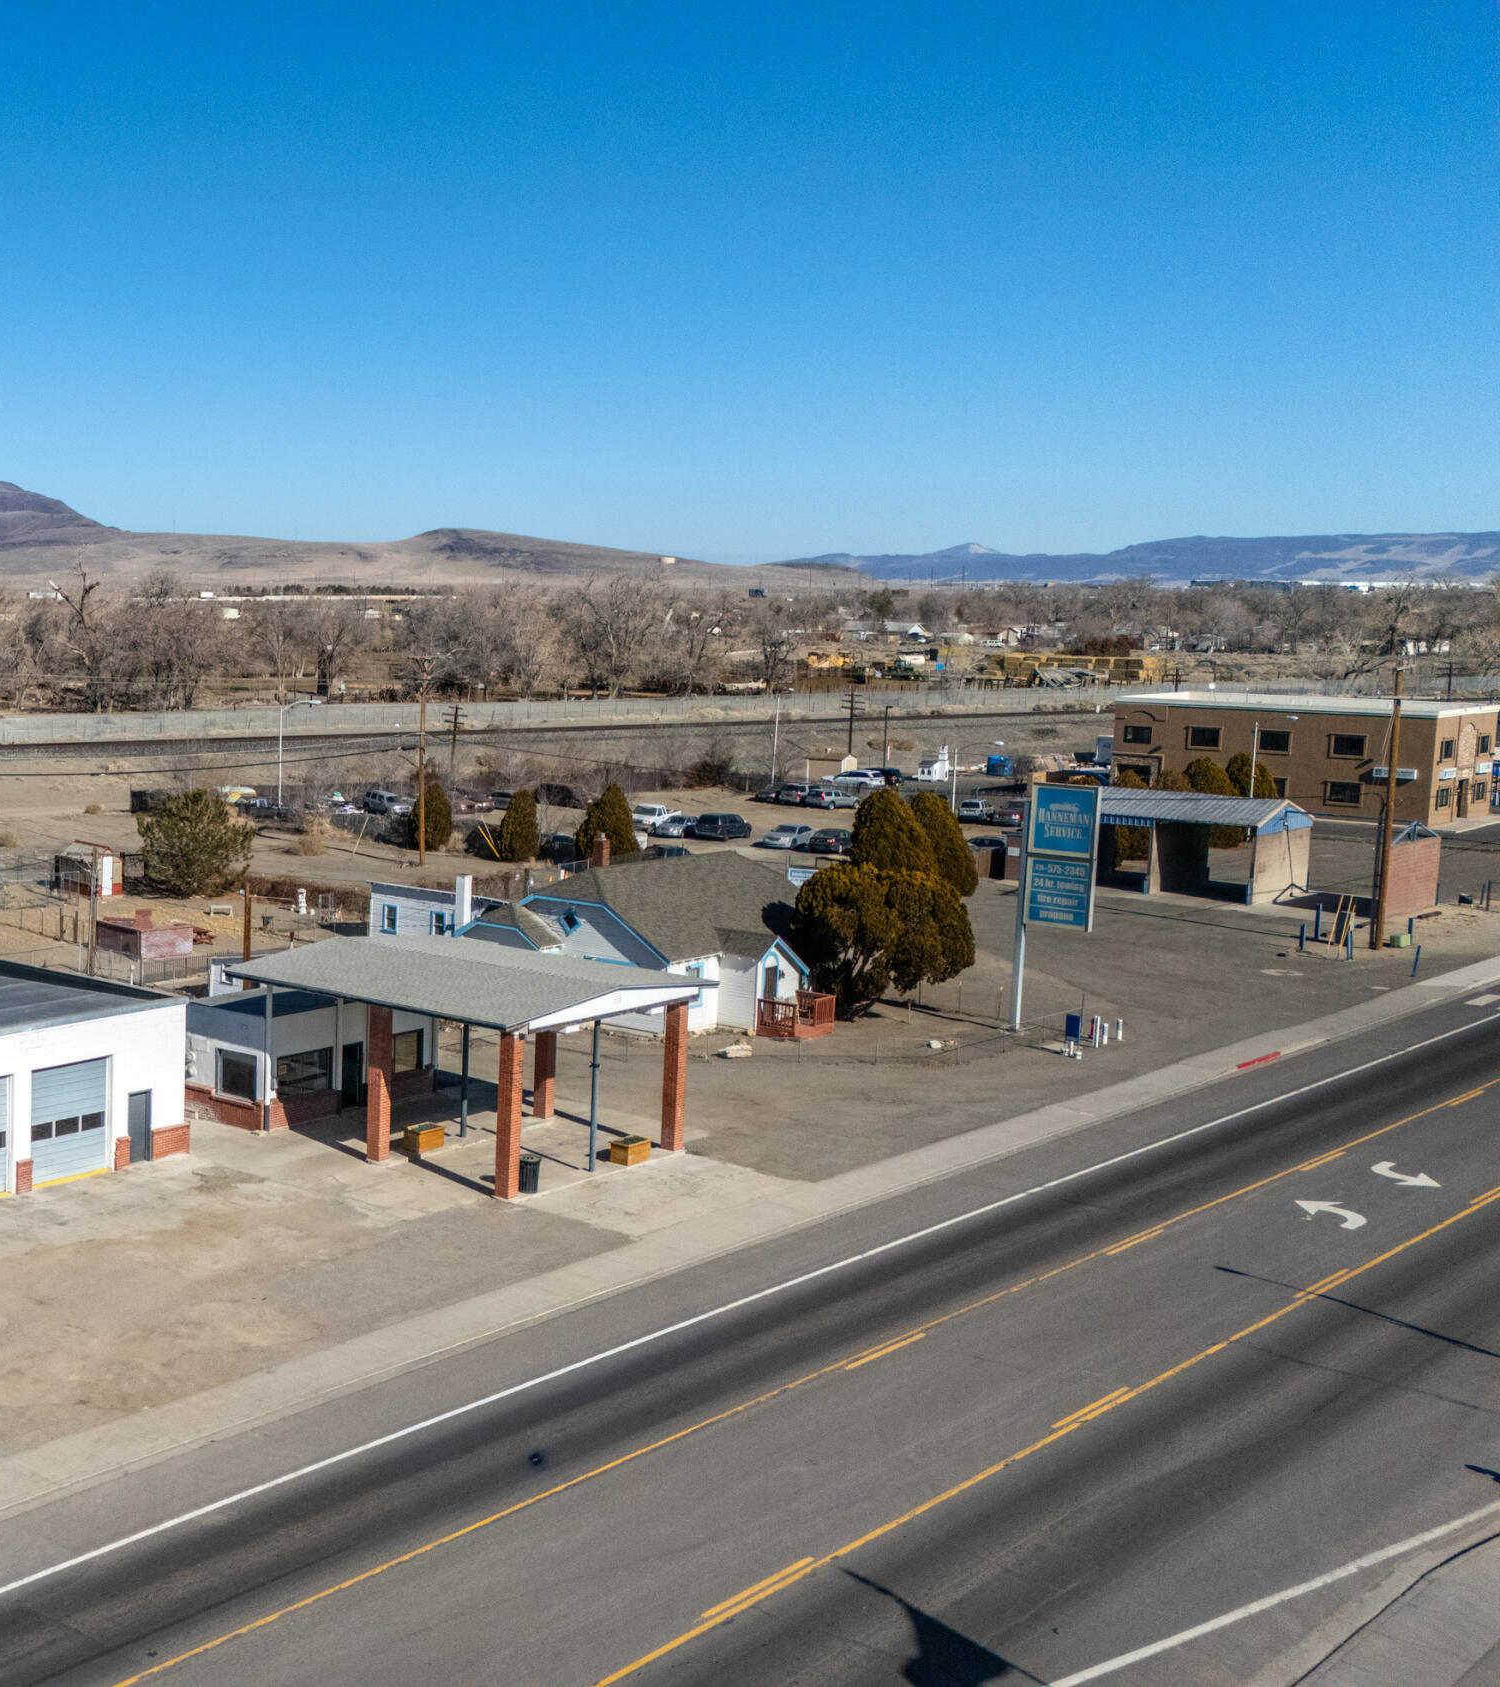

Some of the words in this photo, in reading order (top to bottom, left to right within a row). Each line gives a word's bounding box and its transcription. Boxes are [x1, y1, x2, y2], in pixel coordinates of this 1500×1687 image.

[1038, 807, 1089, 824] HANNEMAN
[1043, 824, 1083, 839] SERVICE
[1034, 877, 1044, 887] 24
[1056, 880, 1084, 893] towing
[1053, 896, 1079, 907] repair
[1039, 909, 1074, 921] propane
